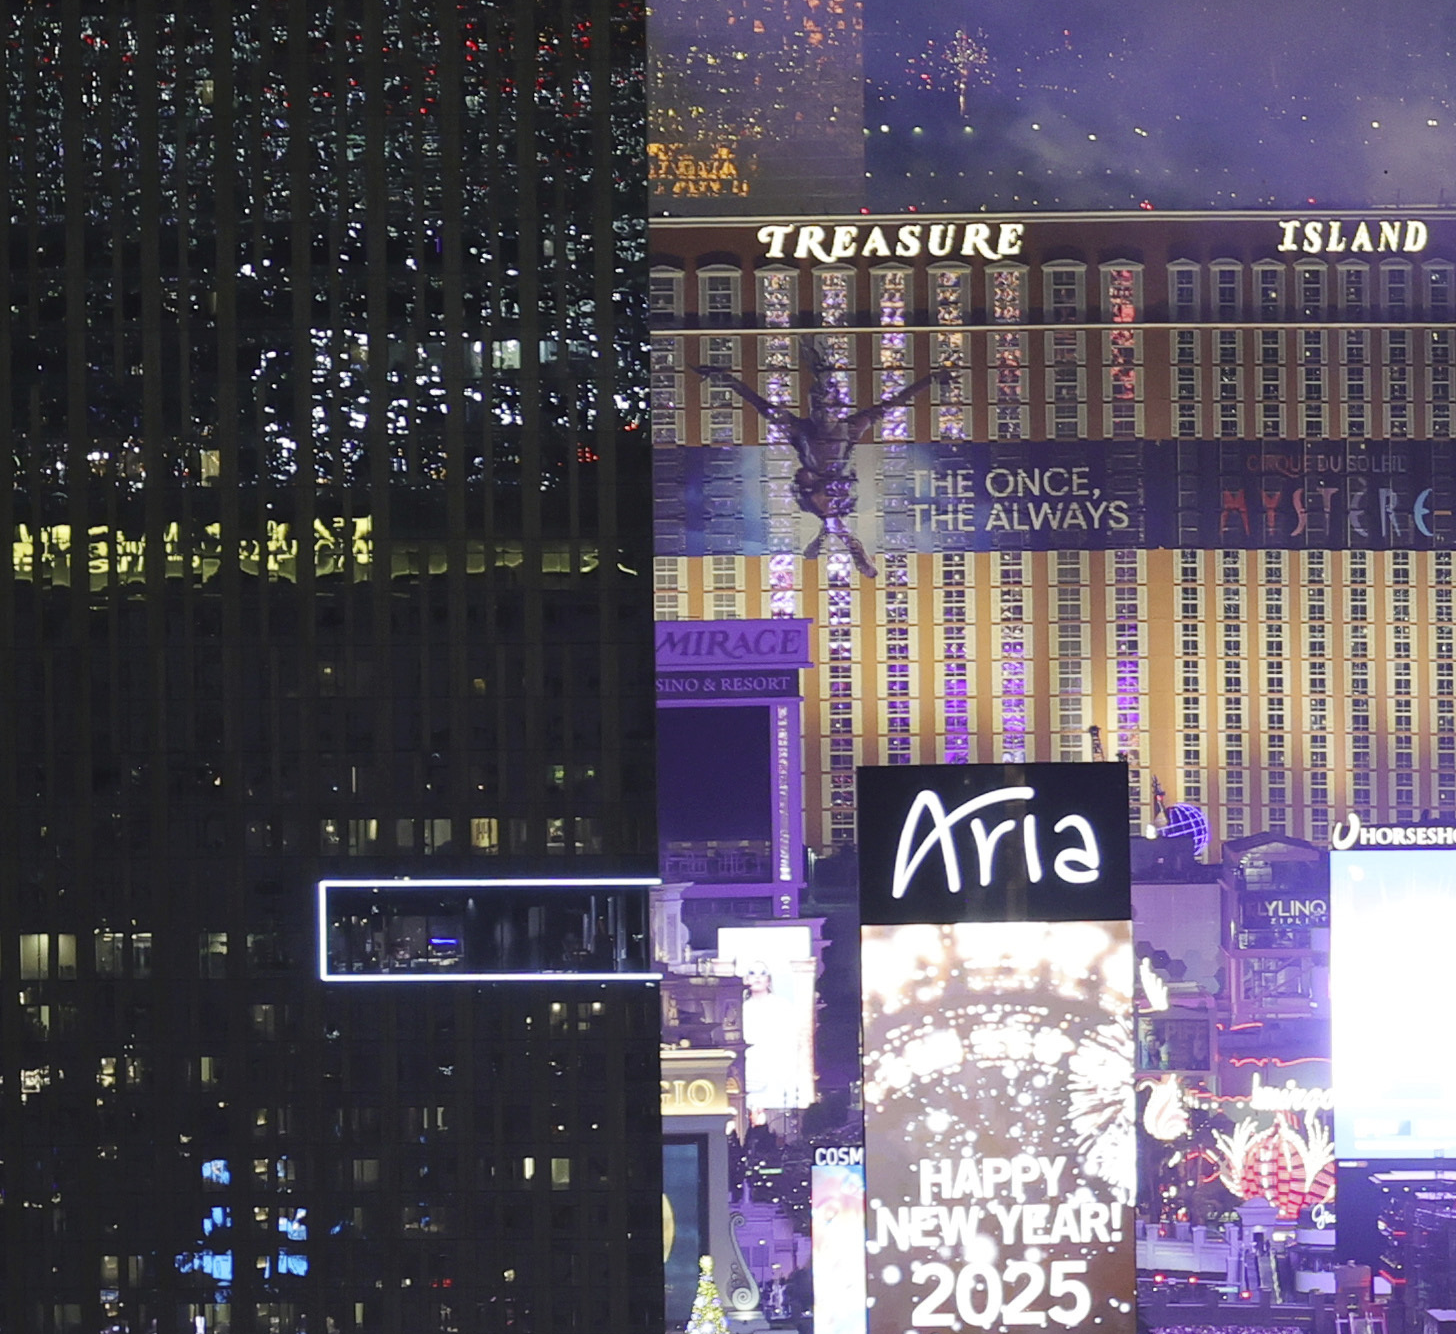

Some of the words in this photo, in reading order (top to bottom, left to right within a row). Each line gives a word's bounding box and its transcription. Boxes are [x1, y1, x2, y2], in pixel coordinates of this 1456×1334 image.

[757, 222, 1024, 263] TREASURE
[1278, 220, 1429, 253] ISLAND
[911, 470, 974, 500] THE
[986, 467, 1101, 502] ONCE,
[910, 503, 975, 533] THE
[985, 500, 1129, 532] ALWAYS
[656, 629, 802, 659] MIRAGE
[703, 678, 716, 692] &
[720, 676, 791, 691] RESORT
[891, 786, 1100, 899] Aria
[919, 1156, 1067, 1203] HAPPY
[876, 1205, 980, 1248] NEW
[994, 1202, 1124, 1245] YEAR!
[910, 1260, 1091, 1328] 2025
